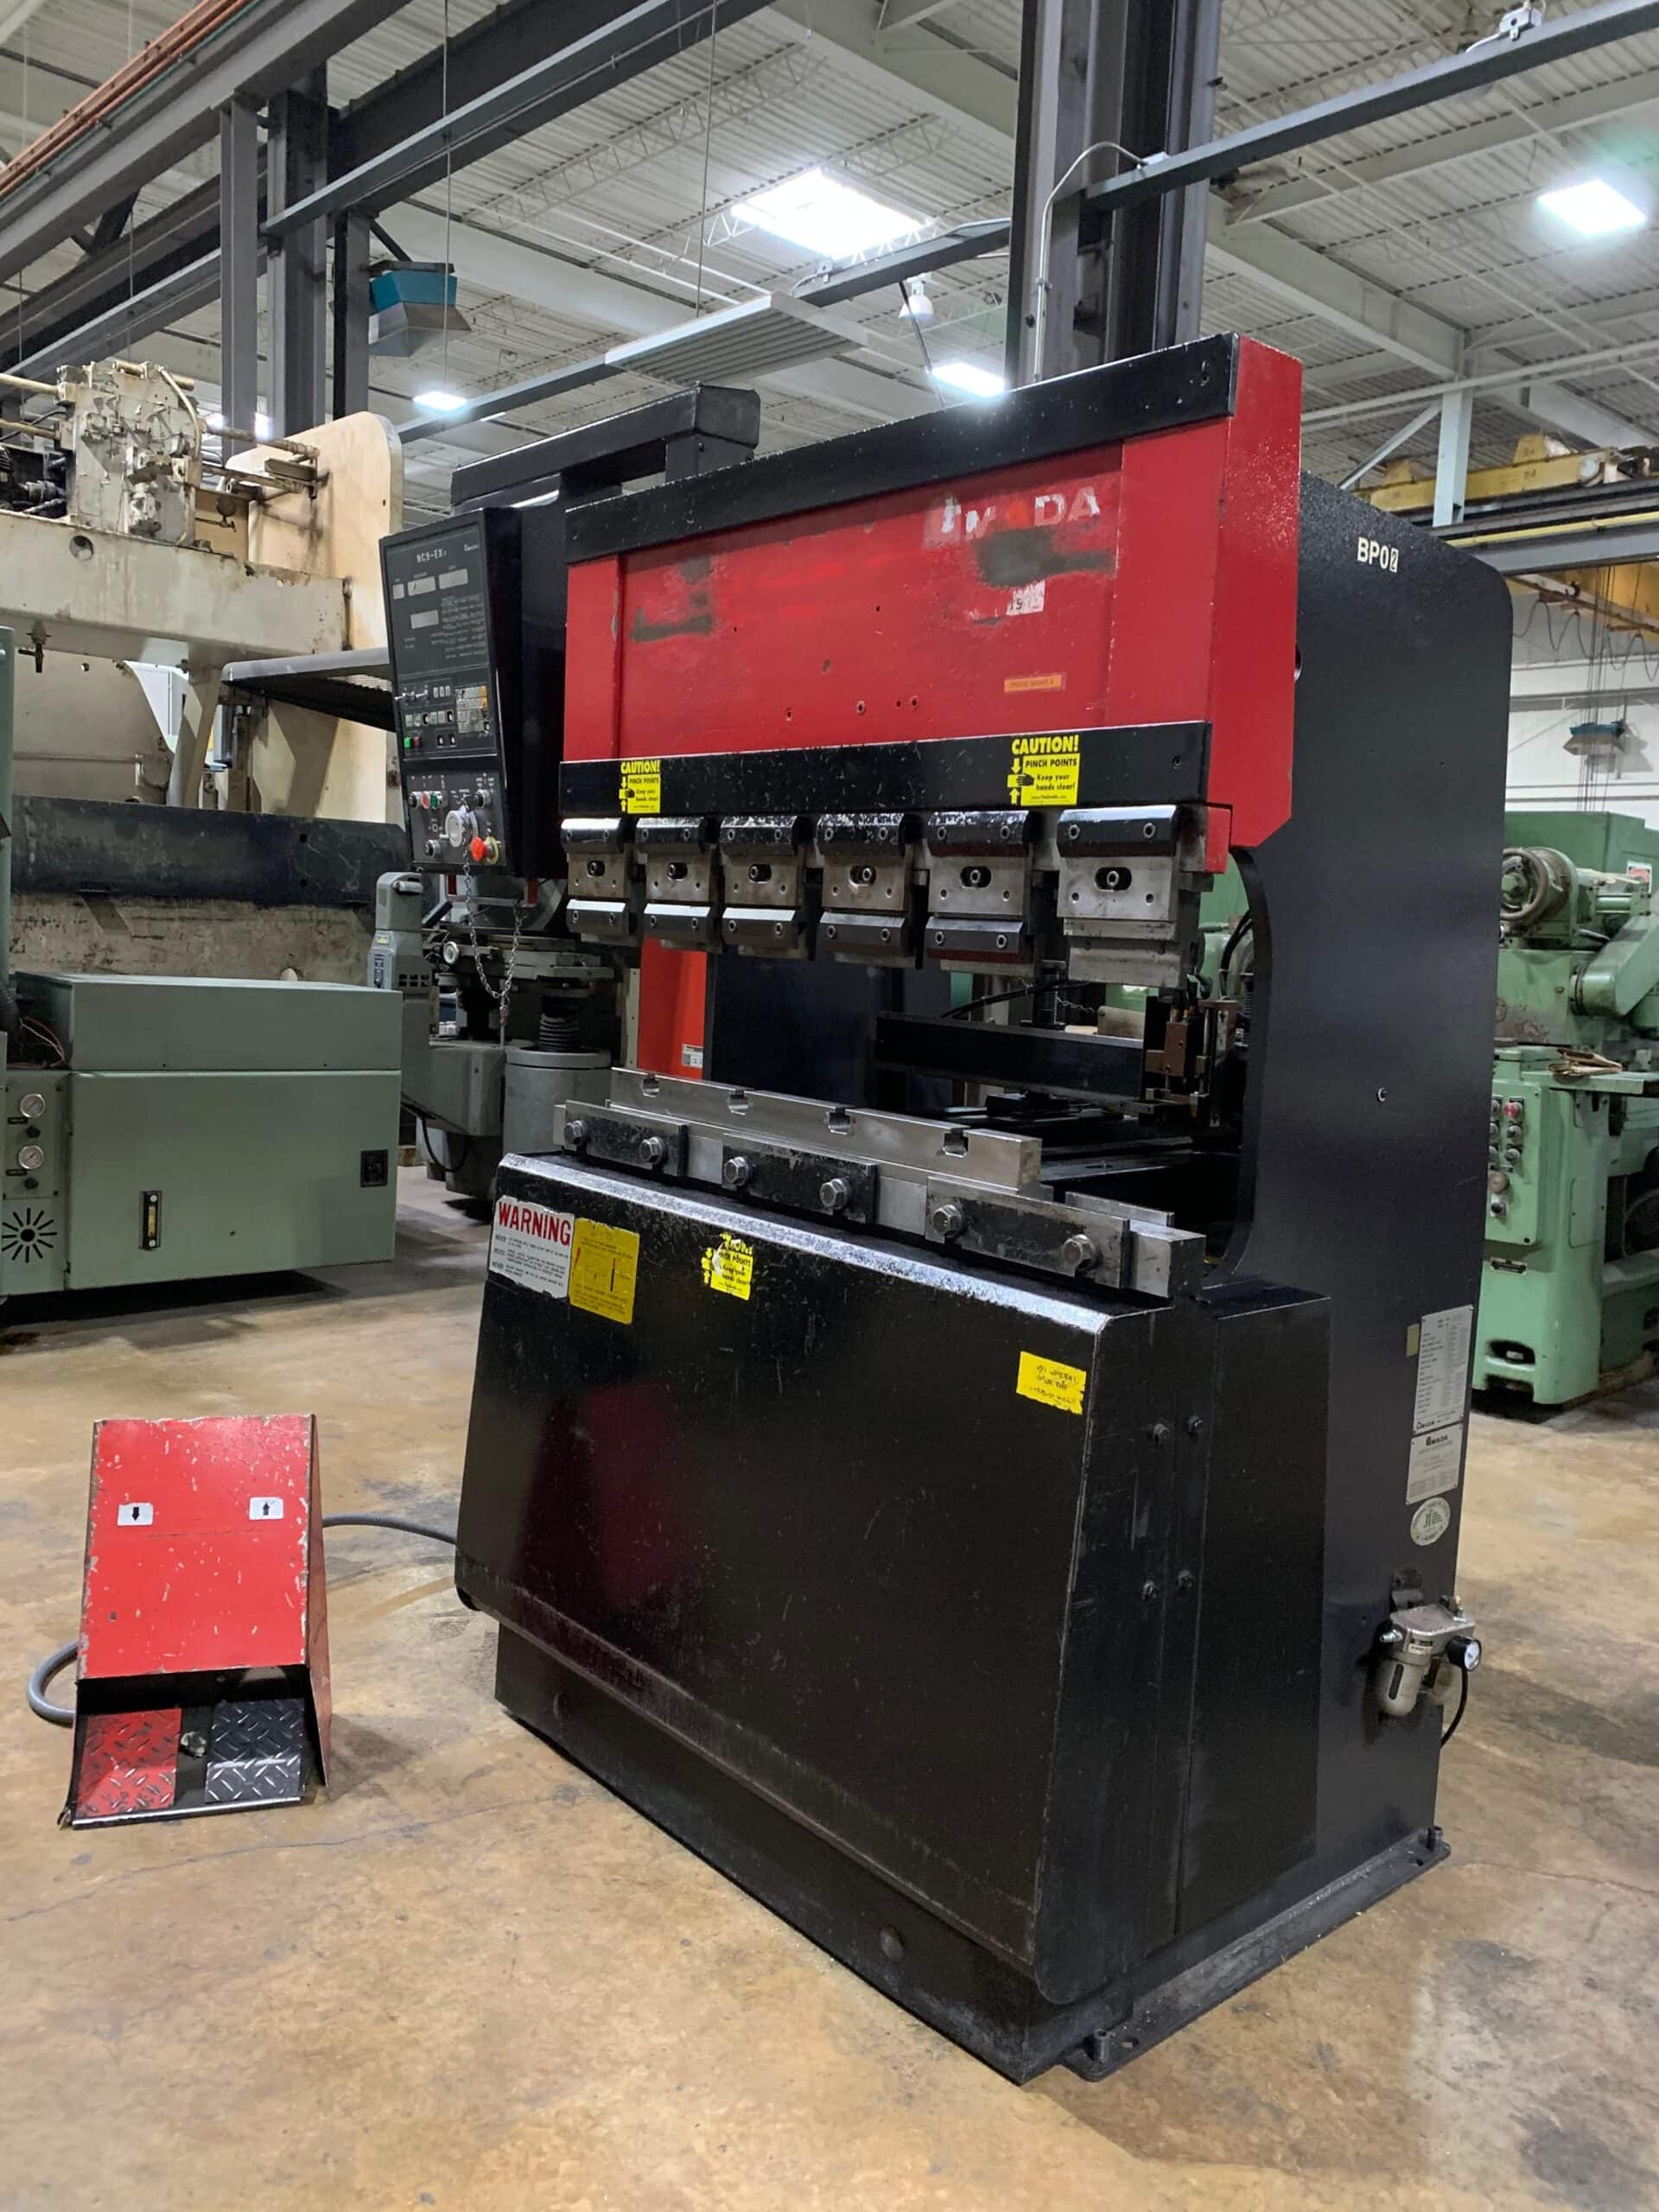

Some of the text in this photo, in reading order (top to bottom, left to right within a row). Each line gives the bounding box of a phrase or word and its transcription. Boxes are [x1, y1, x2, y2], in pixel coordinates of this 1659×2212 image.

[1011, 734, 1079, 754] CAUTION!
[620, 760, 661, 774] CAUTION!
[1050, 759, 1077, 767] POINTS
[498, 1201, 572, 1246] WARNING
